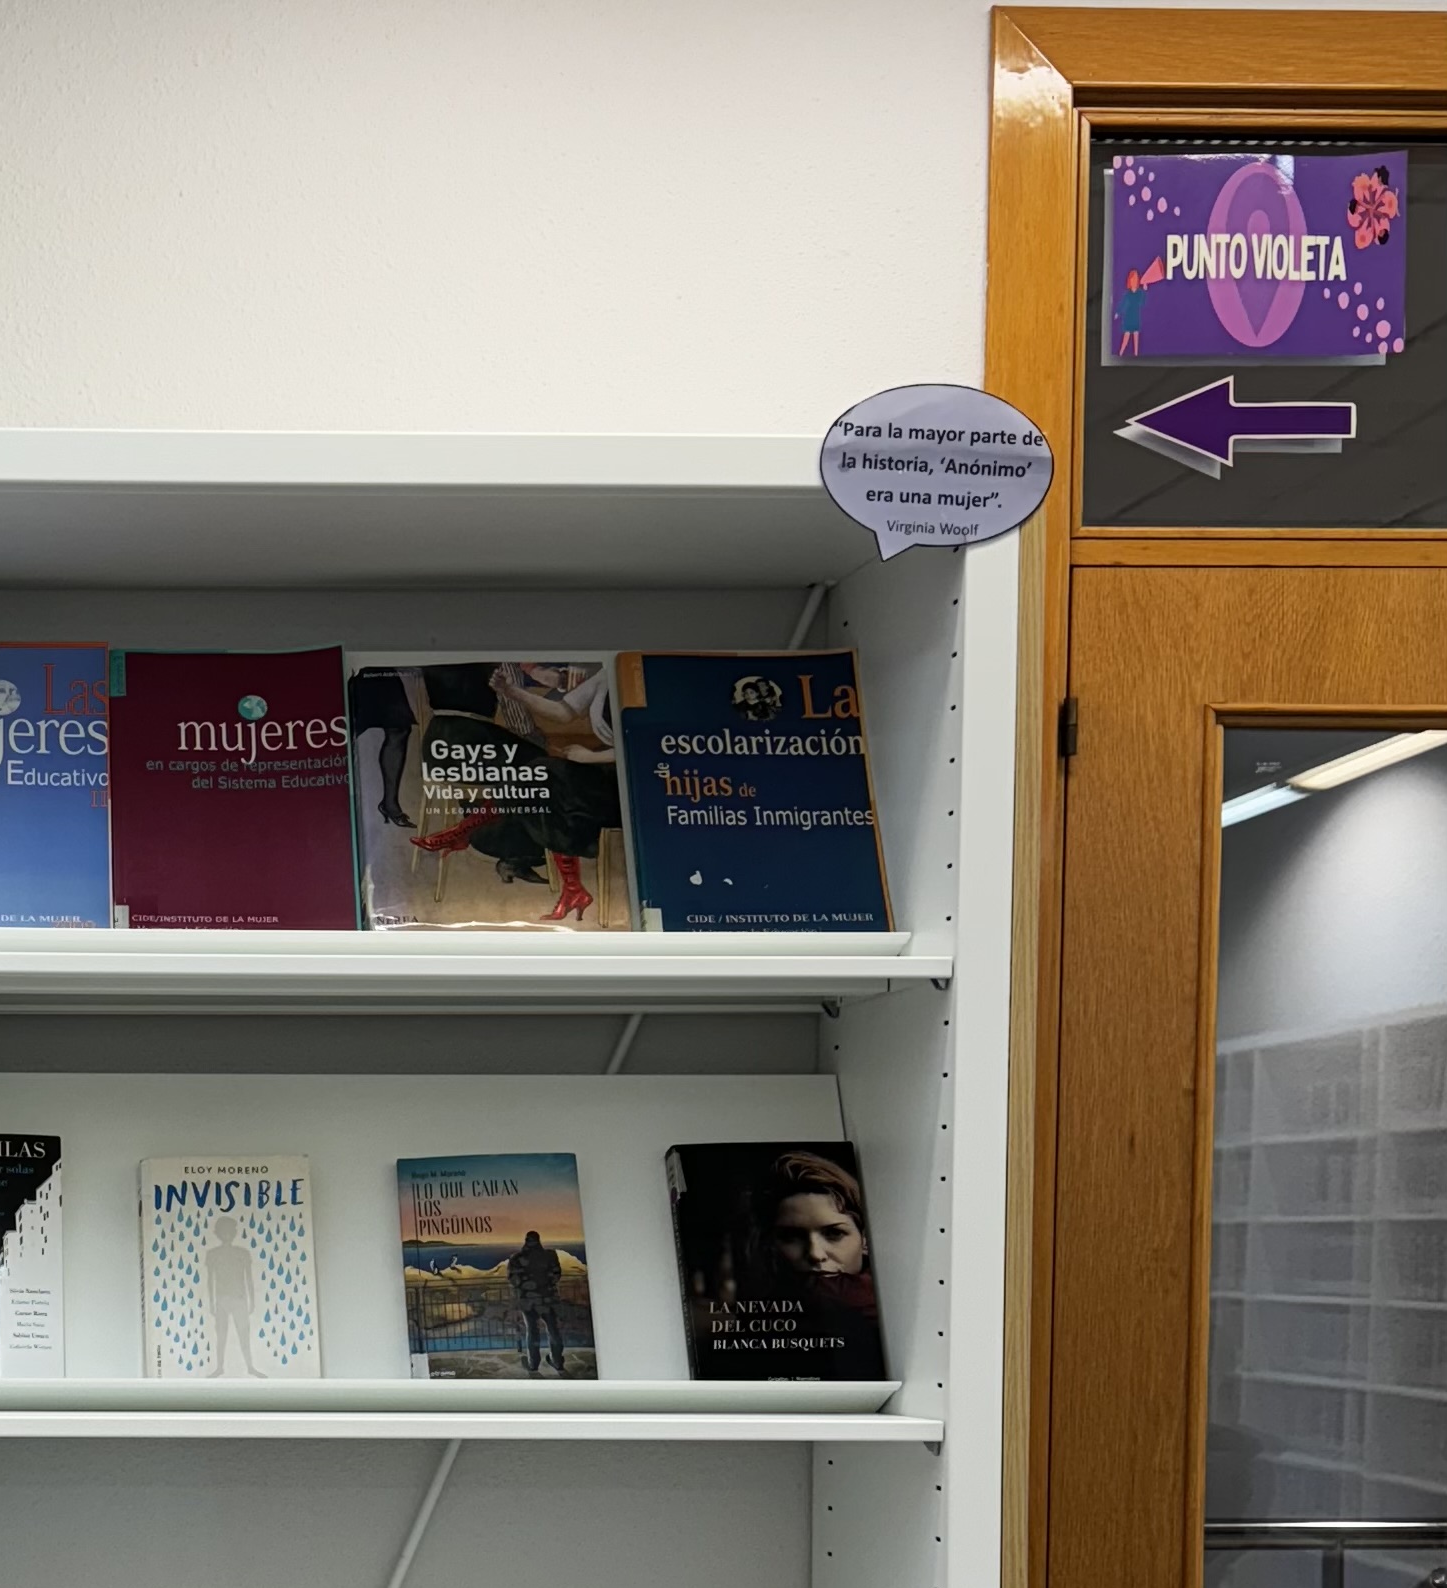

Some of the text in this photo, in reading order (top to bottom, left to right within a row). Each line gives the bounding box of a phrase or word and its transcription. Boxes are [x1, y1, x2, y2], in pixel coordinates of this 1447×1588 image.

[1167, 233, 1346, 282] PUNTO VIOLETA
[888, 423, 902, 439] la
[909, 428, 965, 445] mayor
[970, 431, 1016, 446] parte
[1022, 430, 1043, 446] de
[842, 452, 856, 468] la
[863, 454, 934, 475] historia,
[866, 489, 893, 502] era
[900, 491, 931, 505] una
[887, 520, 979, 536] Virginia Woolf
[43, 663, 109, 716] Las
[797, 674, 860, 719] La
[177, 715, 349, 765] mujeres
[661, 728, 866, 756] escolarización
[431, 739, 518, 764] Gays y
[7, 760, 109, 786] Educativo
[146, 760, 164, 770] en
[169, 761, 216, 773] cargos
[221, 760, 238, 772] de
[422, 762, 549, 783] lesbianas
[192, 773, 350, 789] del Sistema Educativo
[665, 769, 733, 803] hijas
[739, 783, 757, 797] de
[423, 785, 550, 802] Vida y cultura
[445, 807, 487, 815] LEGADO
[491, 806, 551, 814] UNIVERSAL
[667, 806, 874, 831] Familias Inmigrantes
[184, 1166, 269, 1174] ELOY MORENO
[154, 1178, 304, 1213] INVISIBLE
[709, 1300, 804, 1314] LA NEVADA
[712, 1319, 797, 1333] DEL CUCO
[713, 1337, 845, 1351] BLANCA BUSQUETS
